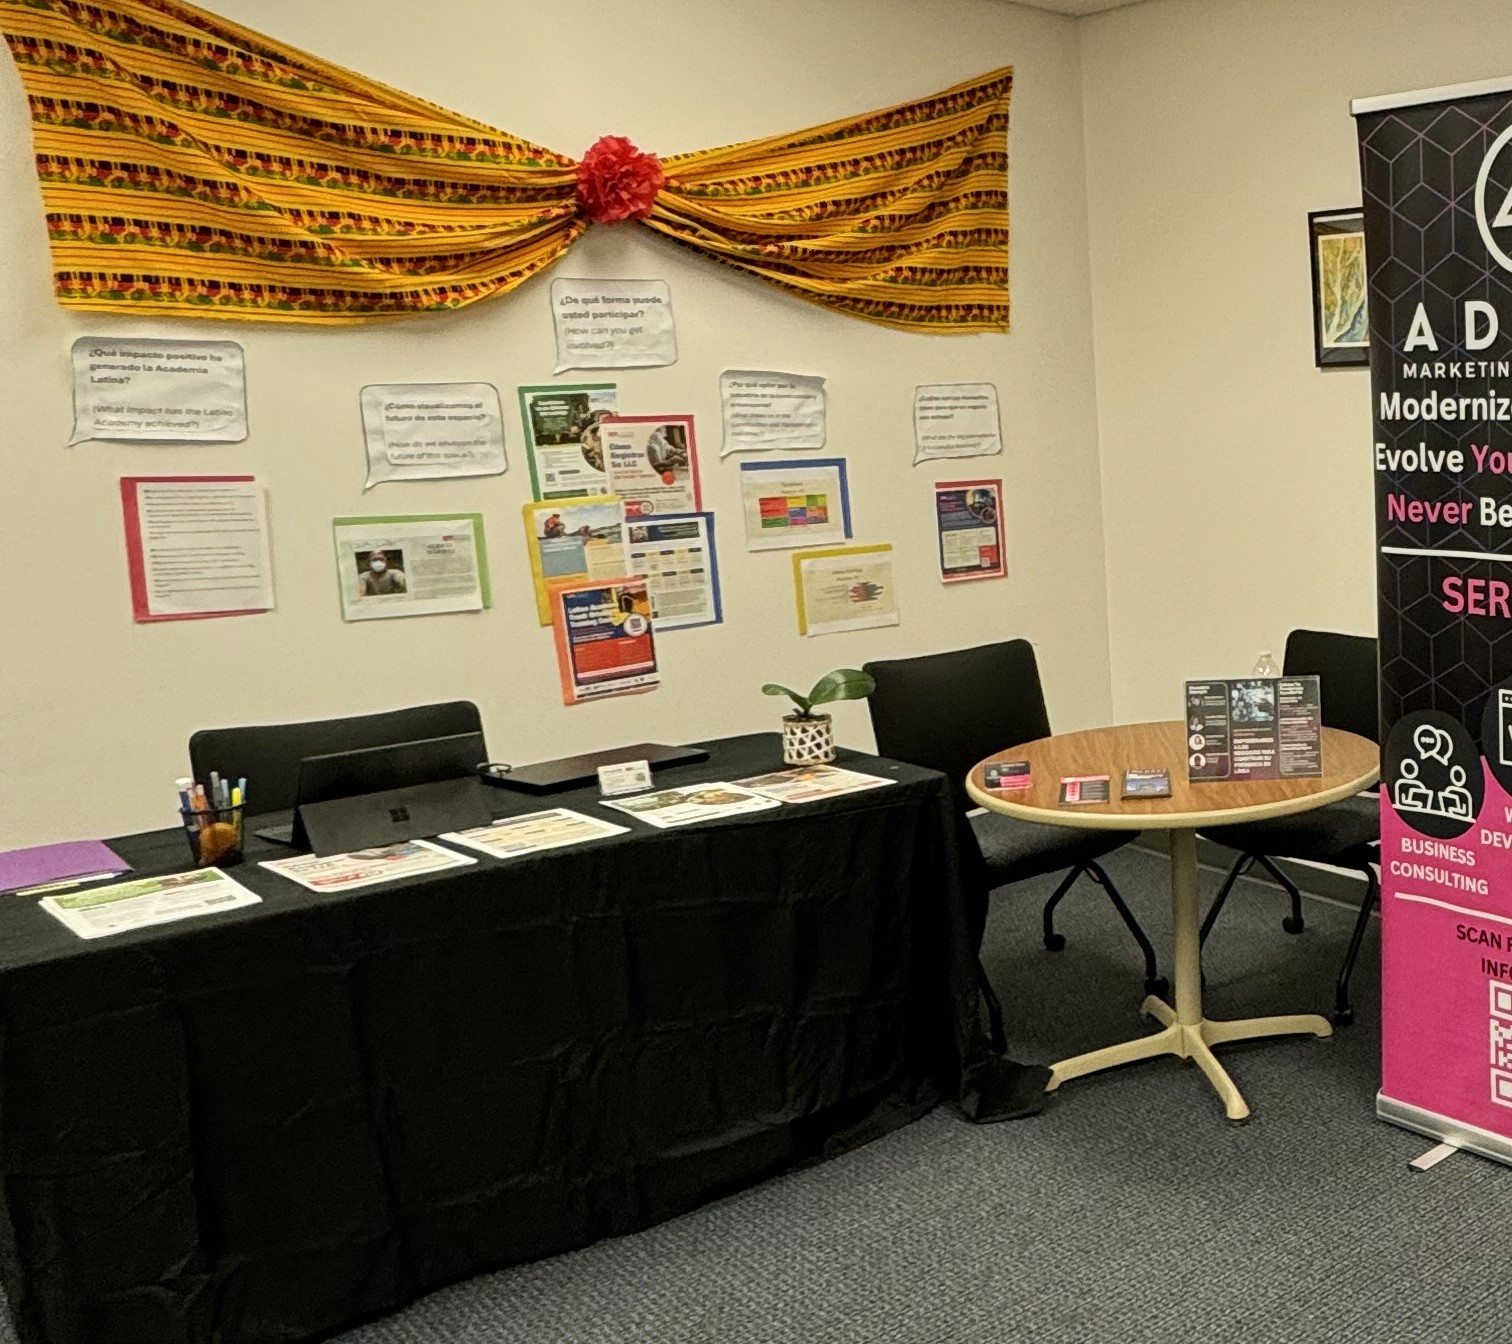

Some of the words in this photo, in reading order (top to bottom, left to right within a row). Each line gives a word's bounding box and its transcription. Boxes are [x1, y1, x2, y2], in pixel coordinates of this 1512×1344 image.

[1375, 443, 1465, 474] Evolve
[1387, 493, 1473, 525] Never
[1401, 836, 1476, 867] BUSINESS
[1390, 860, 1489, 896] CONSULTING
[1456, 923, 1502, 950] SCAN
